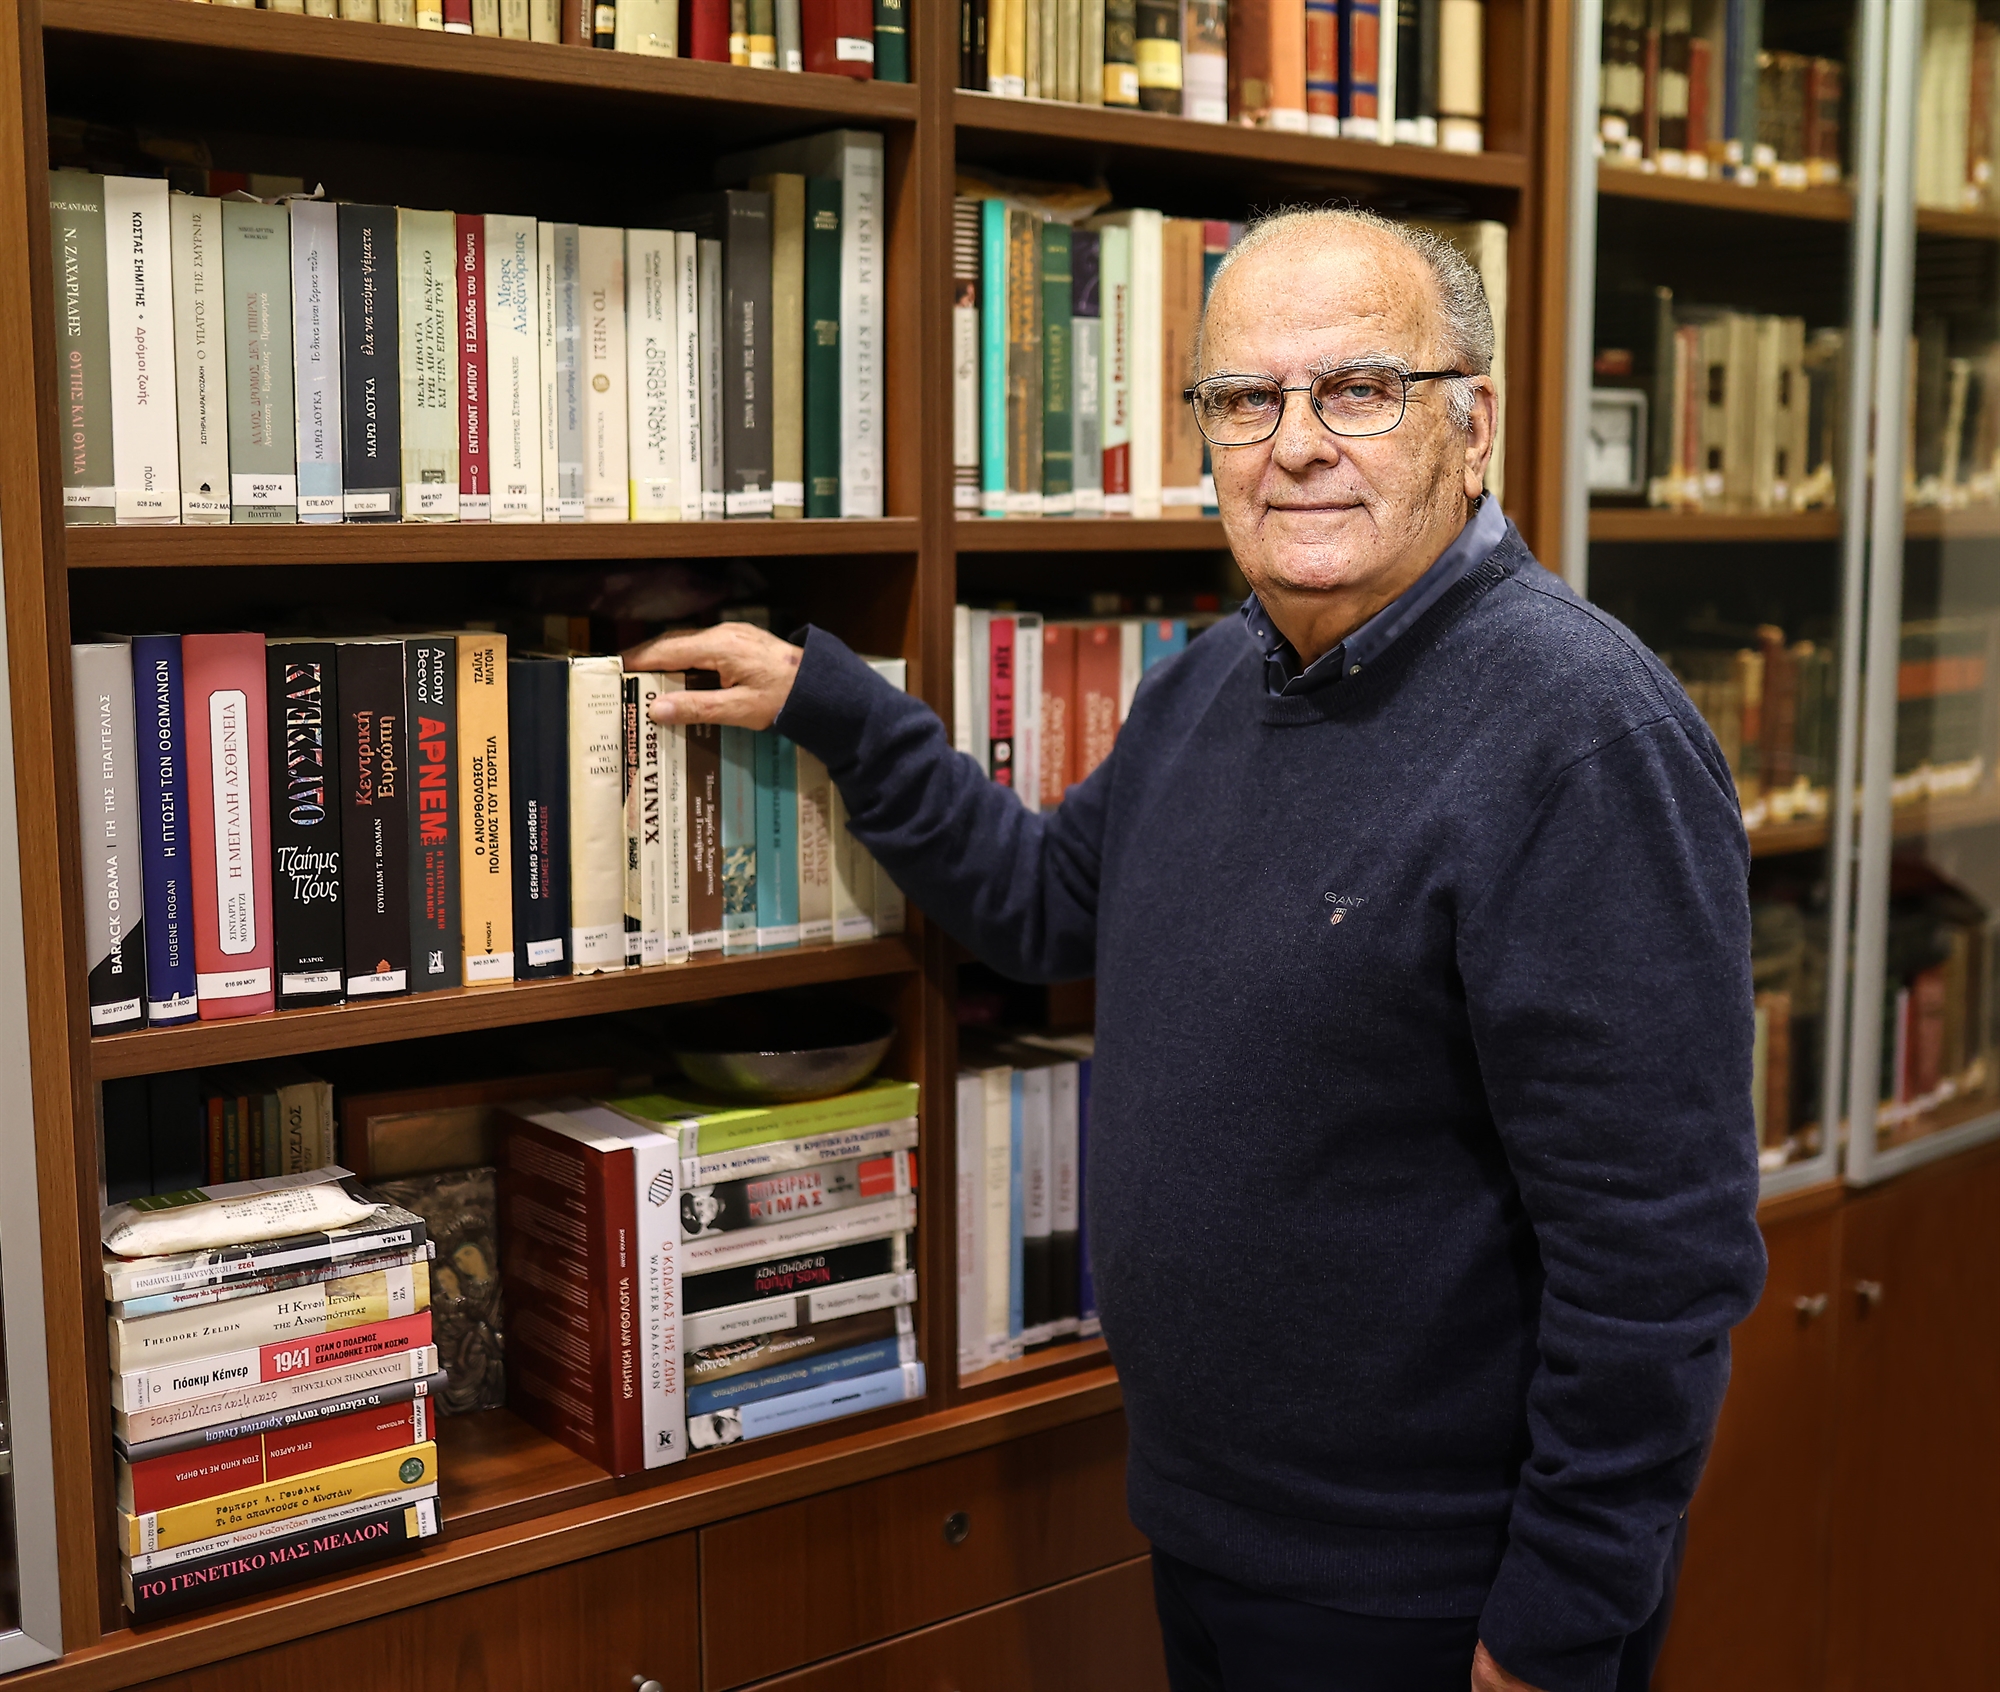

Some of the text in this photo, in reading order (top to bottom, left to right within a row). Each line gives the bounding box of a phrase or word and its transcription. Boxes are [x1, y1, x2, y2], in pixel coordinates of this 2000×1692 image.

[192, 212, 204, 268] ΣΜΥΡΝΗΣ
[64, 245, 82, 337] ΖΑΧΑΡΙΑΔΗΣ
[132, 211, 149, 406] ΚΩΣΤΑΣ ΣΗΜΙΤΗΣ Δρόμοι ζωής
[194, 271, 205, 294] ΤΗΣ
[467, 275, 477, 297] του
[497, 258, 512, 308] Μέρες
[513, 231, 529, 336] Αλεξάνδρειας
[195, 300, 206, 345] ΥΠΑΤΟΣ
[434, 279, 447, 409] ΚΑΙ ΤΗΝ ΕΠΟΧΗ ΤΟΥ
[466, 298, 477, 341] Ελλάδα
[592, 288, 607, 360] ΤΟ ΝΗΣΙ
[414, 322, 425, 408] ΜΕΛΕΤΗΜΑΤΑ
[466, 344, 478, 354] Η
[199, 366, 207, 415] ΜΑΡΑΓΚΟΖΑΚΗ
[466, 362, 478, 402] ΑΜΠΟΥ
[645, 336, 660, 450] ΚΟΙΝΟΣ ΝΟΥΣ
[69, 351, 86, 475] ΘΥΤΗΣ ΚΑΙ ΘΥΜΑ
[200, 415, 208, 445] ΣΩΤΗΡΙΑ
[313, 390, 324, 460] ΜΑΡΩ ΔΟΥΚΑ
[365, 377, 378, 459] ΜΑΡΩ ΔΟΥΚΑ
[468, 404, 479, 454] ΕΝΤΜΟΝΤ
[417, 648, 430, 704] Beevor
[431, 647, 446, 706] Antony
[485, 648, 495, 686] ΜΙΛΤΟΝ
[99, 694, 117, 839] ΓΗ ΤΗΣ ΕΠΑΓΓΕΛΙΑΣ
[155, 660, 176, 857] Η ΠΤΩΣΗ ΤΩΝ ΟΘΩΜΑΝΩΝ
[285, 662, 326, 826] ΟΔΥΣΣΕΑΣ
[352, 710, 375, 807] Κεντρική
[376, 715, 399, 799] Ευρώπη
[589, 743, 619, 752] ΟΡΑΜΑ
[589, 765, 619, 775] ΙΩΝΙΑΣ
[222, 702, 242, 879] Η ΜΕΓΑΛΗ ΑΣΘΕΝΕΙΑ
[418, 716, 449, 845] ΑΡΝΕΜ
[473, 756, 486, 856] Ο ΑΝΟΡΘΟΔΟΞΟΣ
[486, 735, 500, 874] ΠΟΛΕΜΟΣ ΤΟΥ ΤΣΟΡΤΣΙΛ
[644, 771, 660, 846] ΧΑΝΙΑ
[277, 846, 340, 877] Τζαίημς
[527, 799, 540, 900] GERHARD SCHRÖDER
[540, 805, 550, 899] ΚΡΙΣΙΜΕΣ ΑΠΟΦΑΣΕΙΣ
[291, 874, 340, 905] Τζόυς
[425, 851, 435, 920] ΤΩΝ ΓΕΡΜΑΝΩΝ
[1324, 891, 1365, 908] GANT
[107, 855, 123, 975] BARACK OBAMA
[166, 880, 180, 967] EUGENE ROGAN
[228, 896, 237, 941] ΣΙΝΤΑΡΤΑ
[237, 892, 248, 943] ΜΟΥΚΕΡΤΖΙ
[299, 956, 325, 964] ΚΕΔΡΟΣ
[746, 1172, 822, 1201] ΕΠΙΧΕΙΡΗΣΗ
[749, 1190, 823, 1219] ΚΙΜΑΣ
[136, 1275, 170, 1289] ΣΜΥΡΝΗ
[237, 1261, 255, 1270] 1922
[315, 1333, 377, 1353] ΟΤΑΝ Ο ΠΟΛΕΜΟΣ
[619, 1276, 634, 1400] ΚΡΗΤΙΚΗ ΜΥΘΟΛΟΓΙΑ
[649, 1255, 661, 1390] WALTER ISAACSON
[662, 1241, 677, 1397] Ο ΚΩΔΙΚΑΣ ΤΗΣ ΖΩΗΣ
[173, 1366, 249, 1391] Γιόακιμ Κέπνερ
[273, 1347, 310, 1373] 1941
[315, 1337, 409, 1365] ΕΞΑΠΛΩΘΗΚΕ ΣΤΟΝ ΚΟΣΜΟ
[205, 1394, 381, 1443] Το τελευταίο τανγκό Χριστίνα Ωνάση
[176, 1454, 259, 1481] ΣΤΟΝ ΚΗΠΟ ΜΕ ΤΑ ΘΗΡΙΑ
[270, 1441, 313, 1458] ΕΡΙΚ ΛΑΡΣΟΝ
[215, 1517, 227, 1527] Τι
[230, 1513, 243, 1524] θα
[247, 1501, 299, 1520] απαντούσε
[313, 1488, 353, 1504] Αϊνστάιν
[139, 1580, 167, 1600] ΤΟ
[171, 1554, 266, 1592] ΓΕΝΕΤΙΚΟ
[269, 1543, 310, 1566] ΜΑΣ
[313, 1520, 390, 1555] ΜΕΛΛΟΝ
